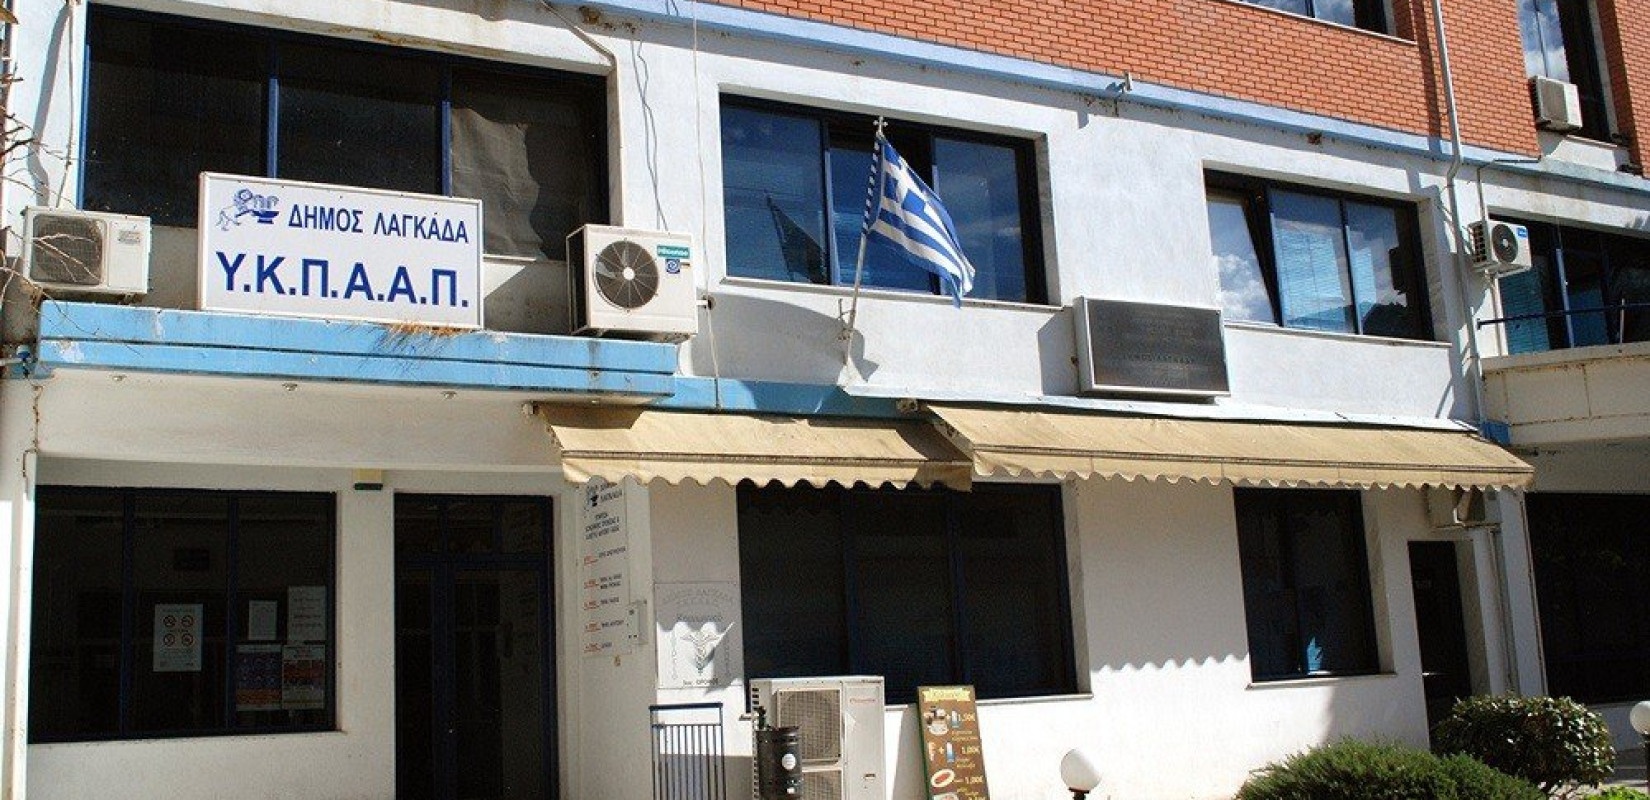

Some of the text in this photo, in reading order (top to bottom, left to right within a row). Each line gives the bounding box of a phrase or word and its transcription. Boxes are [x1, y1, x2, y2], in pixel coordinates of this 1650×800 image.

[288, 203, 469, 243] ΔΗΜΟΣ ΛΑΓΚΑΔΑ
[215, 251, 469, 308] Υ.Κ.Π.Α.Α.Π.
